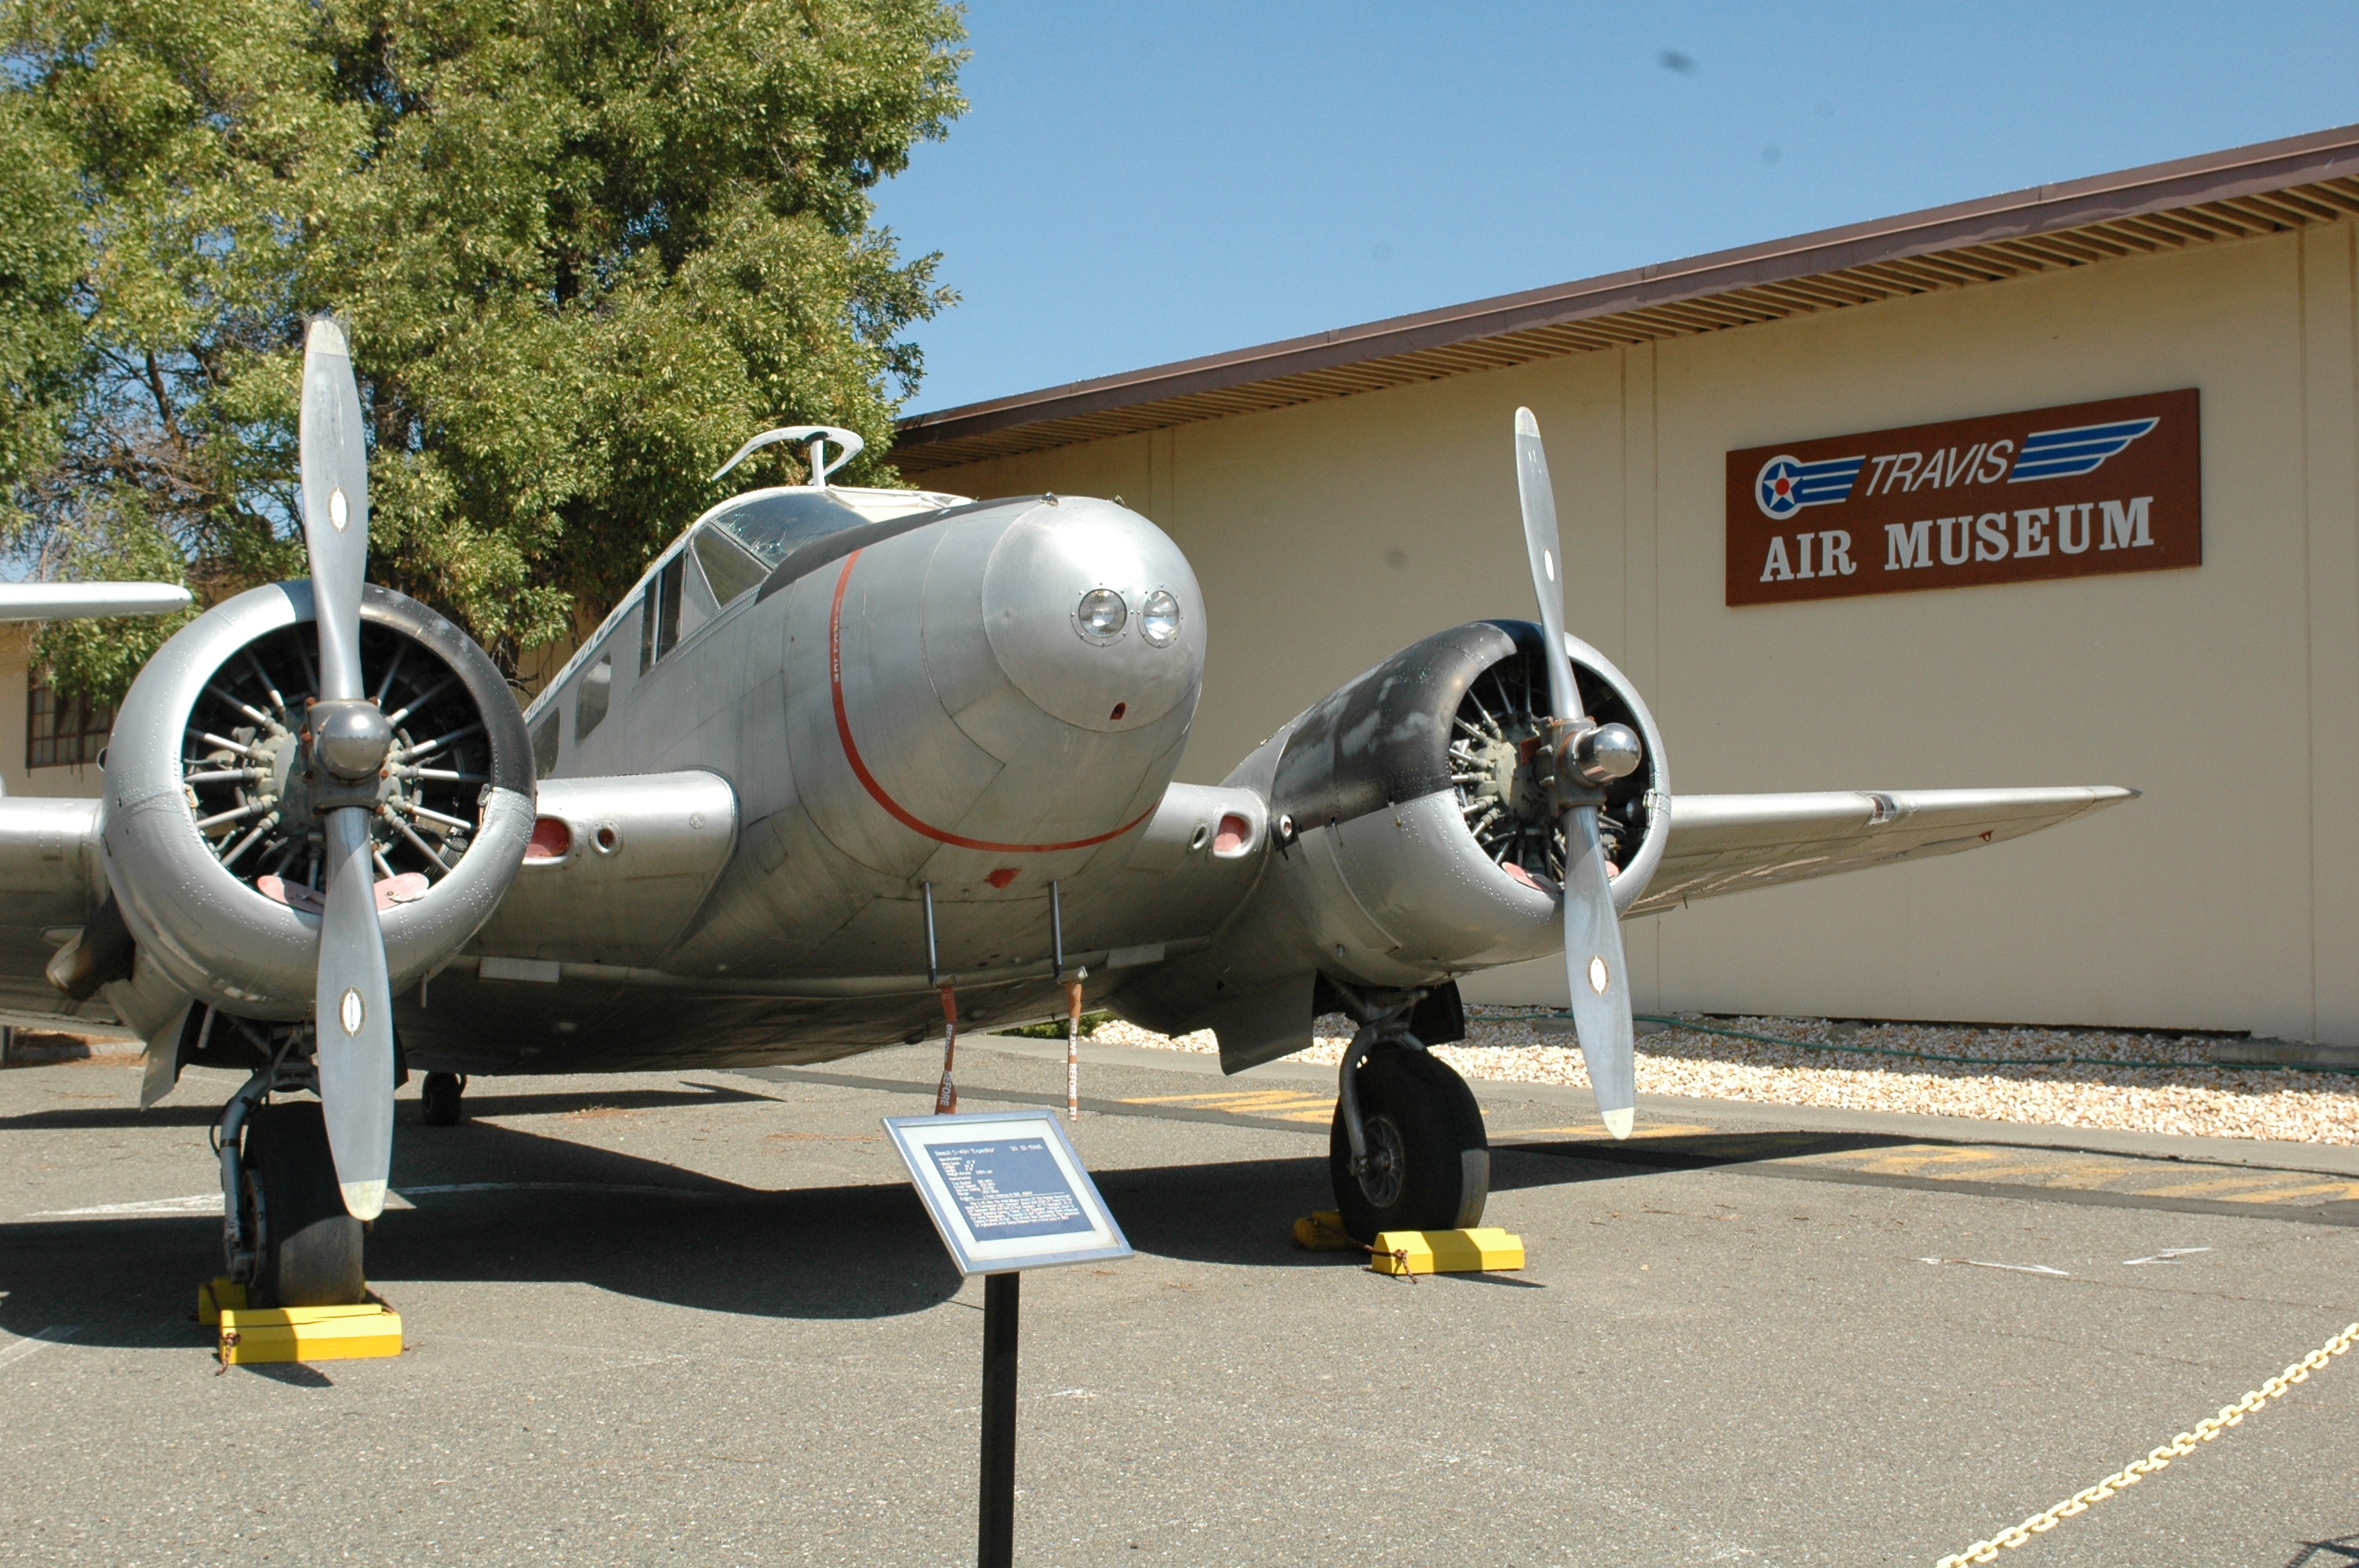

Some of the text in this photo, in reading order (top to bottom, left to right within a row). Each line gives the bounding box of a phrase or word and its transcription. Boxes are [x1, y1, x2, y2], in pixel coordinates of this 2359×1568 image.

[1866, 439, 2013, 495] TRAVIS
[1759, 496, 2154, 583] AIR MUSEUM
[940, 1071, 952, 1107] BEFORE
[1068, 1063, 1077, 1099] BEFORE
